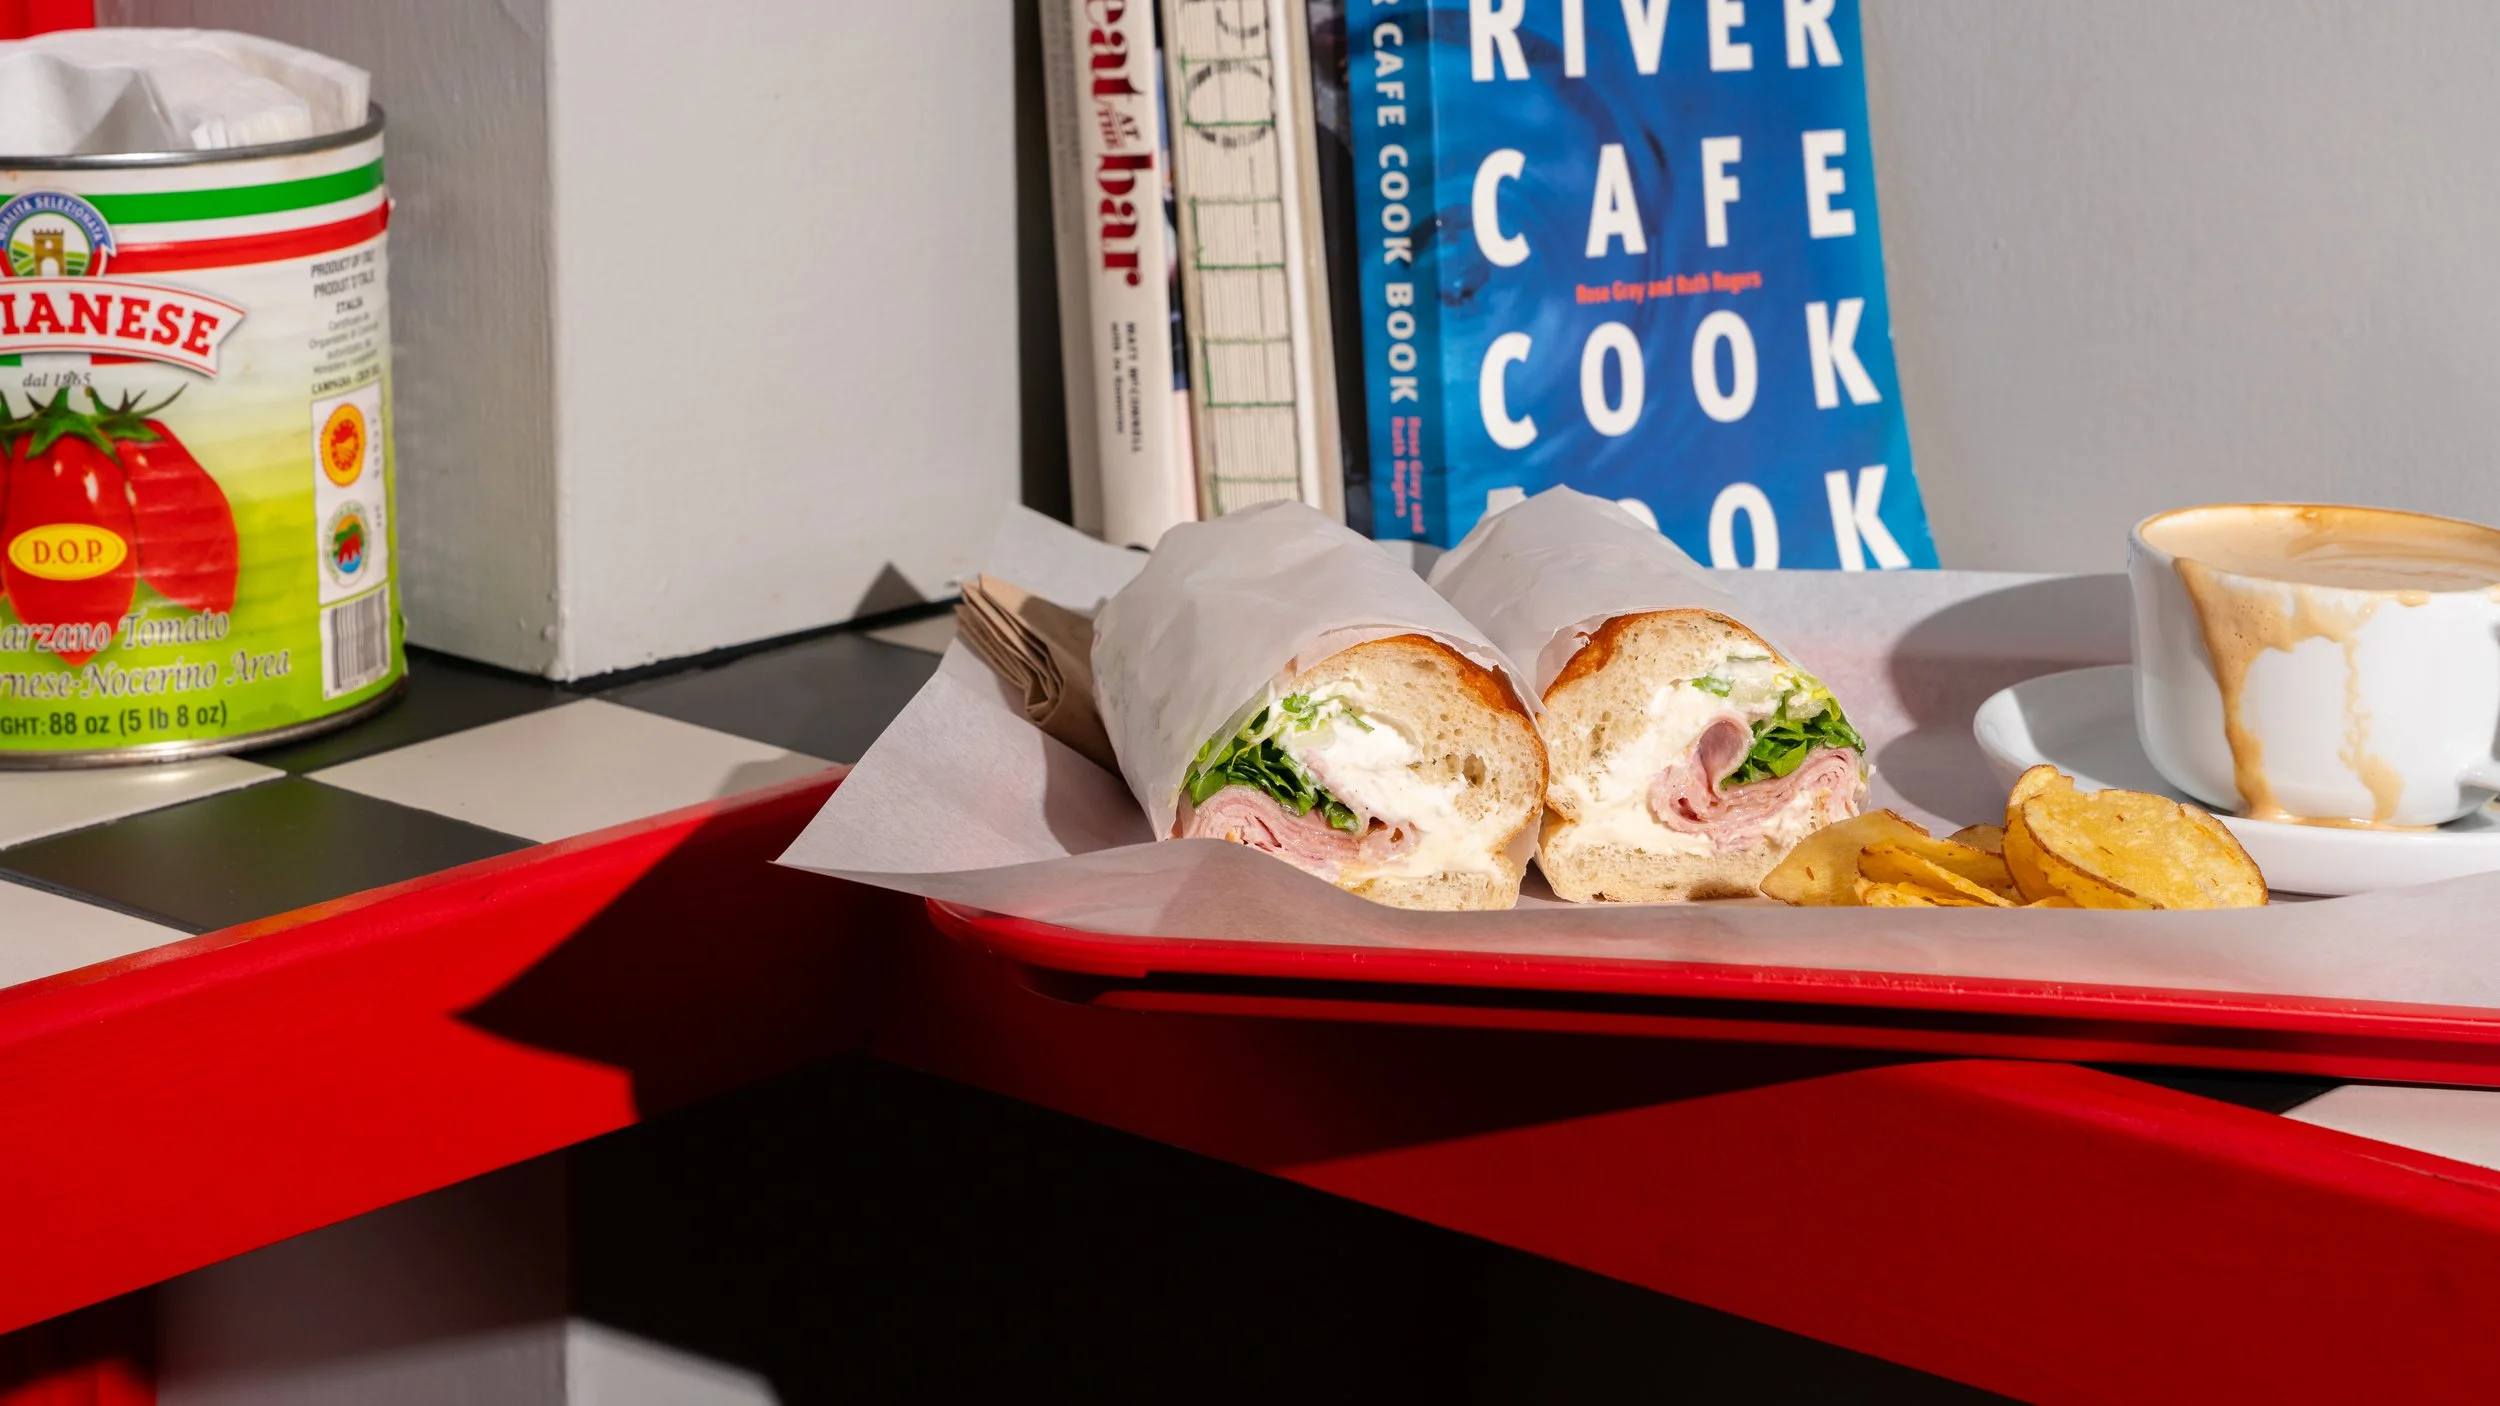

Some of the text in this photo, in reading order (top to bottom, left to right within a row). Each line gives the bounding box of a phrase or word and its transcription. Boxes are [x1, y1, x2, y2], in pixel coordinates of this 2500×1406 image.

[1469, 0, 1843, 82] RIVER
[1096, 106, 1121, 150] THE
[1117, 111, 1143, 141] AT
[1095, 151, 1154, 288] bar
[1373, 22, 1418, 404] CAFE COOK BOOK
[1470, 128, 1857, 268] CAFE
[1575, 269, 1763, 305] Rose Gray and Ruth Rogers
[22, 372, 48, 387] dal
[1478, 296, 1882, 451] COOK
[1391, 416, 1408, 518] Ruth Rogers
[1407, 416, 1426, 534] Rose Gray and
[1486, 465, 1911, 571] OK
[33, 539, 103, 565] D.O.P.
[118, 607, 229, 652] Tomato
[225, 648, 292, 686] Area
[49, 711, 77, 736] 88
[85, 715, 110, 735] oz
[119, 706, 142, 737] (5
[149, 704, 169, 732] lb
[177, 703, 189, 727] 8
[196, 699, 228, 730] oz)
